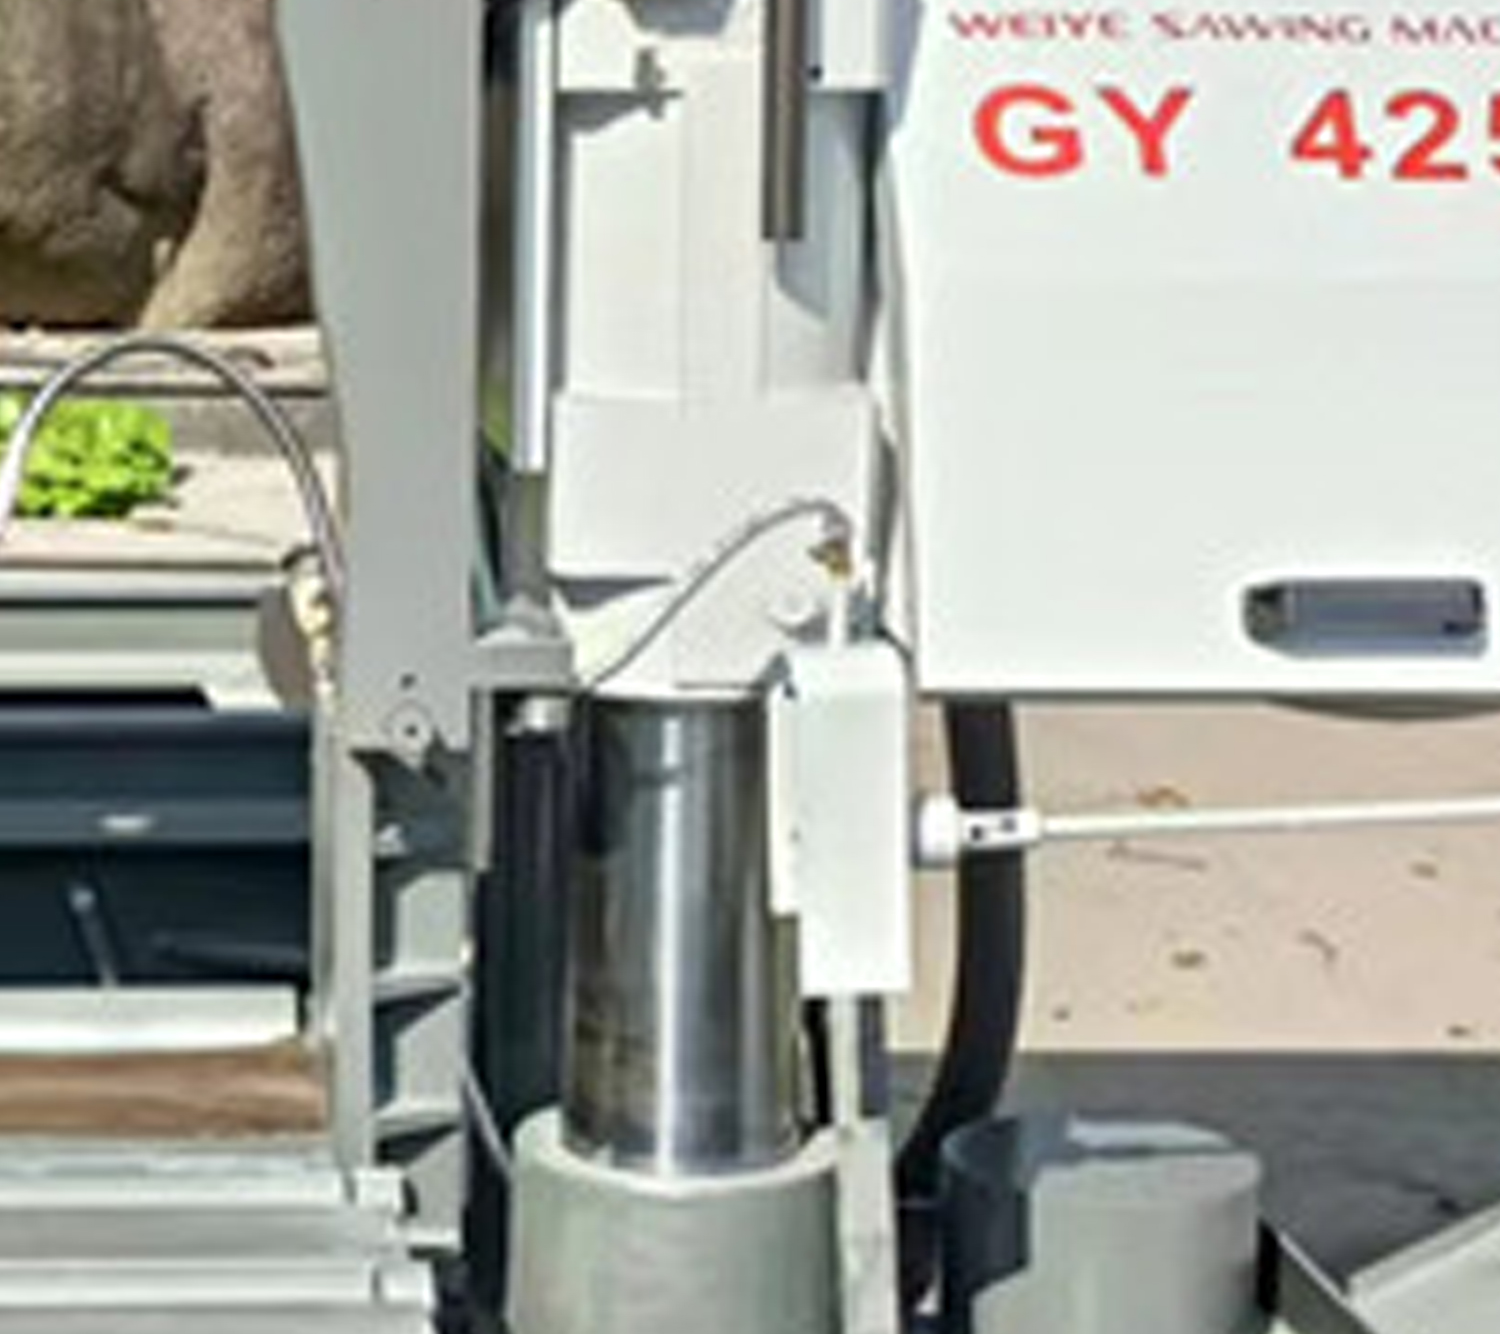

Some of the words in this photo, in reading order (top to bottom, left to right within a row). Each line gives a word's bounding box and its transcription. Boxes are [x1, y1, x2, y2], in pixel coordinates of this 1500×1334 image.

[949, 12, 1130, 42] WEIYE
[1152, 12, 1371, 44] SAWING
[972, 82, 1193, 180] GY
